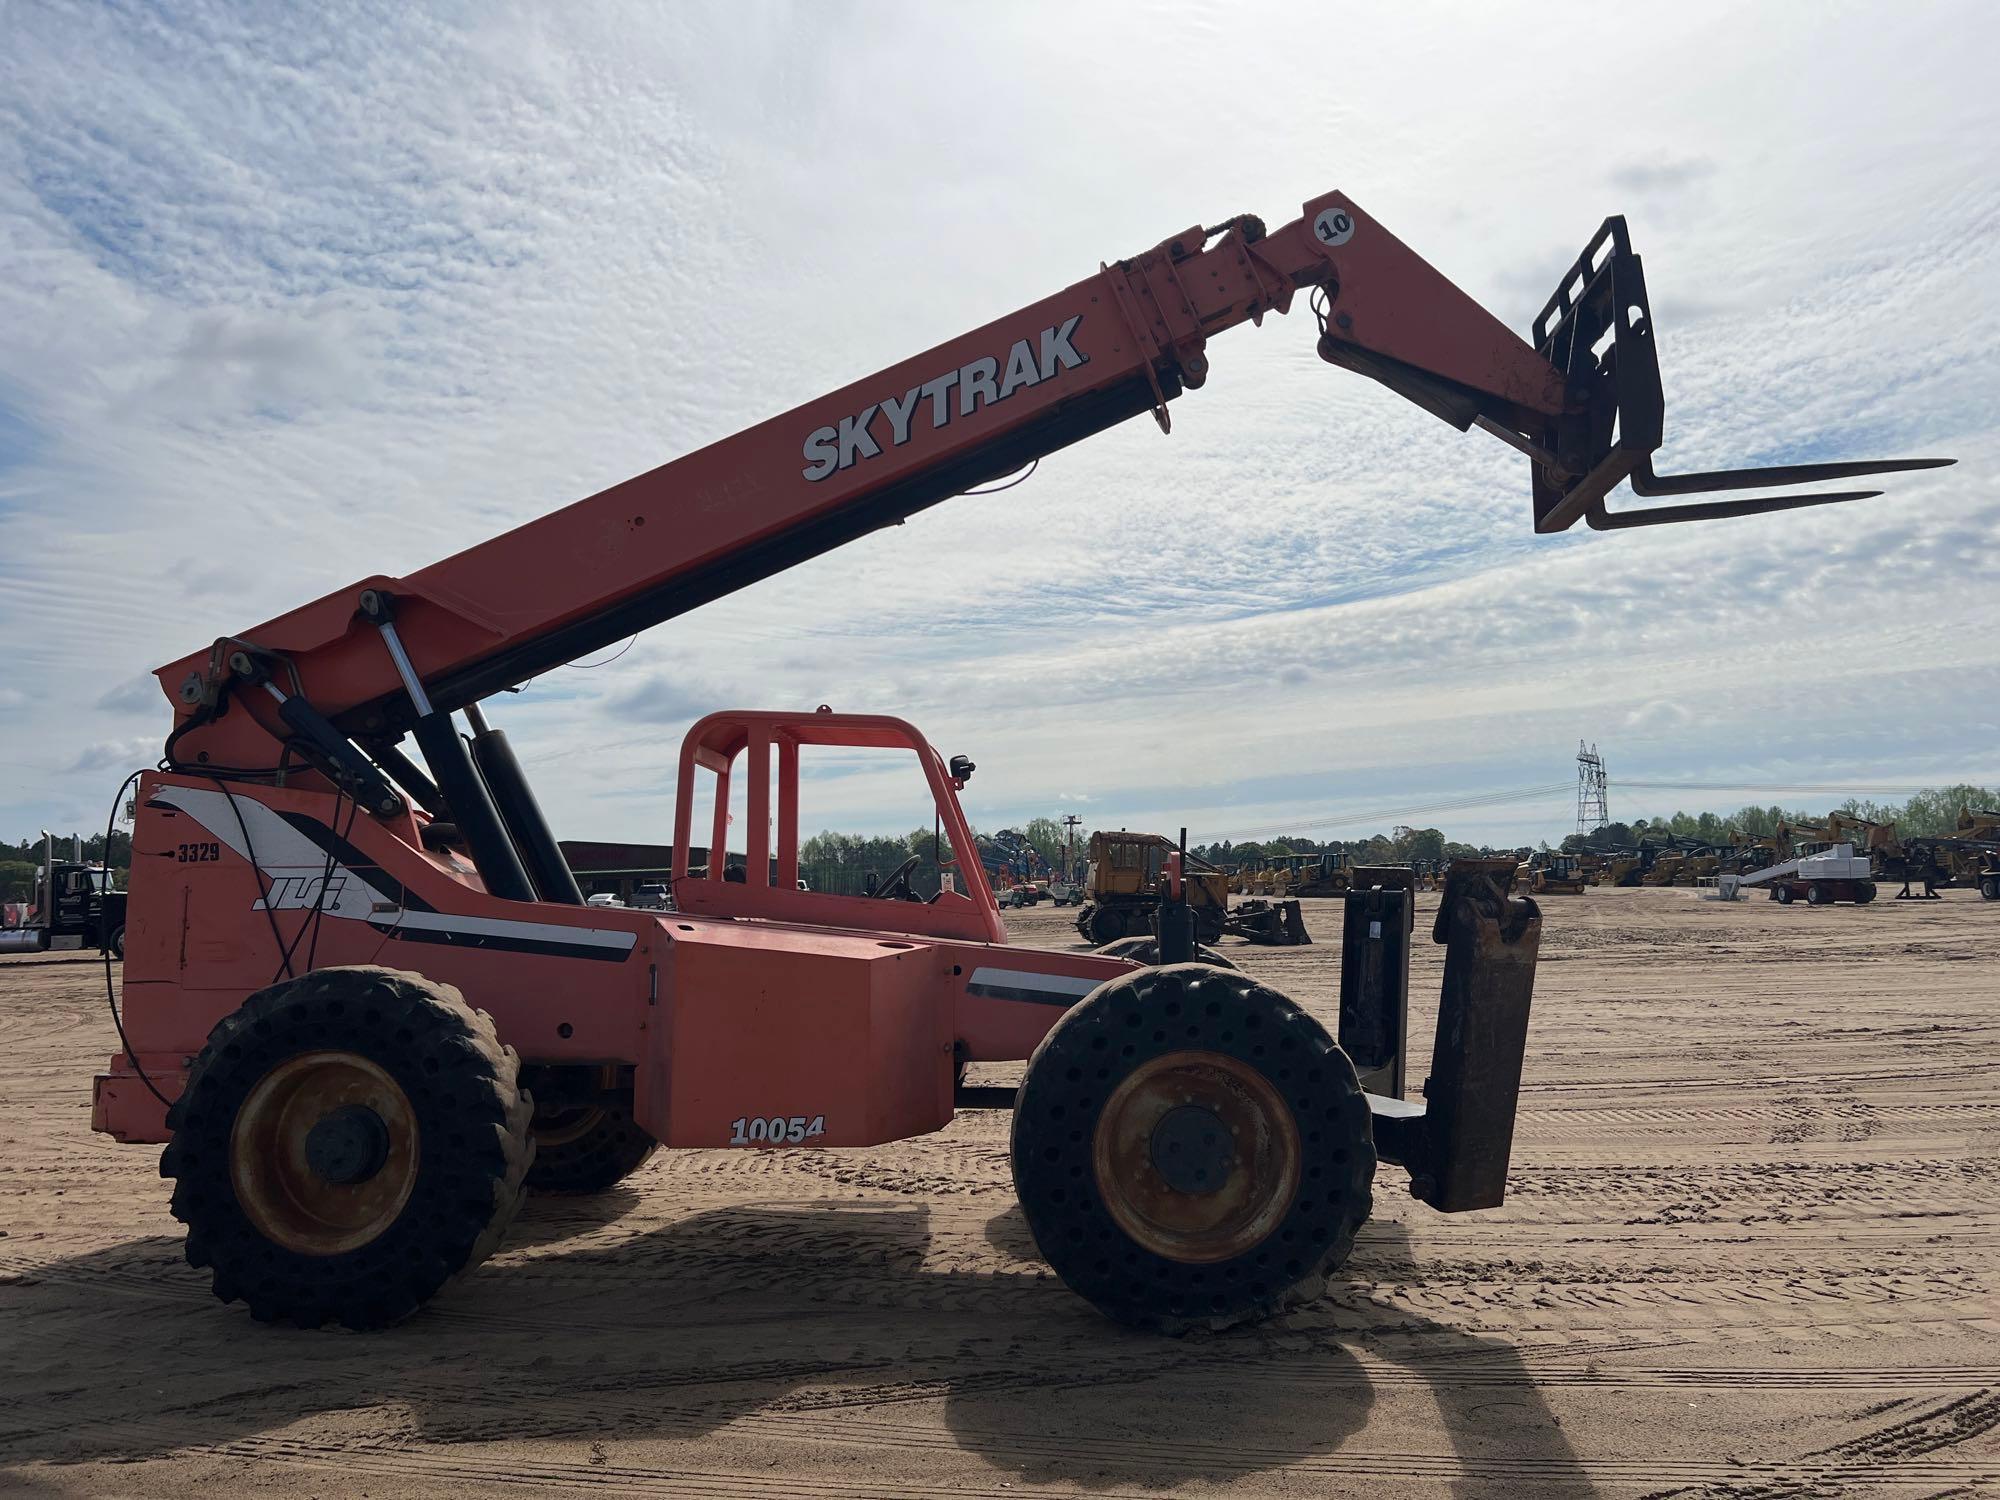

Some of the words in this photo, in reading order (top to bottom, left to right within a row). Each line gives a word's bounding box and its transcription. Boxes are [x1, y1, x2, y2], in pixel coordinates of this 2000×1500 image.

[1319, 214, 1350, 241] 10
[802, 315, 1084, 481] SKYTRAK
[178, 843, 219, 862] 3329
[251, 876, 347, 911] JLG
[730, 1116, 826, 1145] 10054
